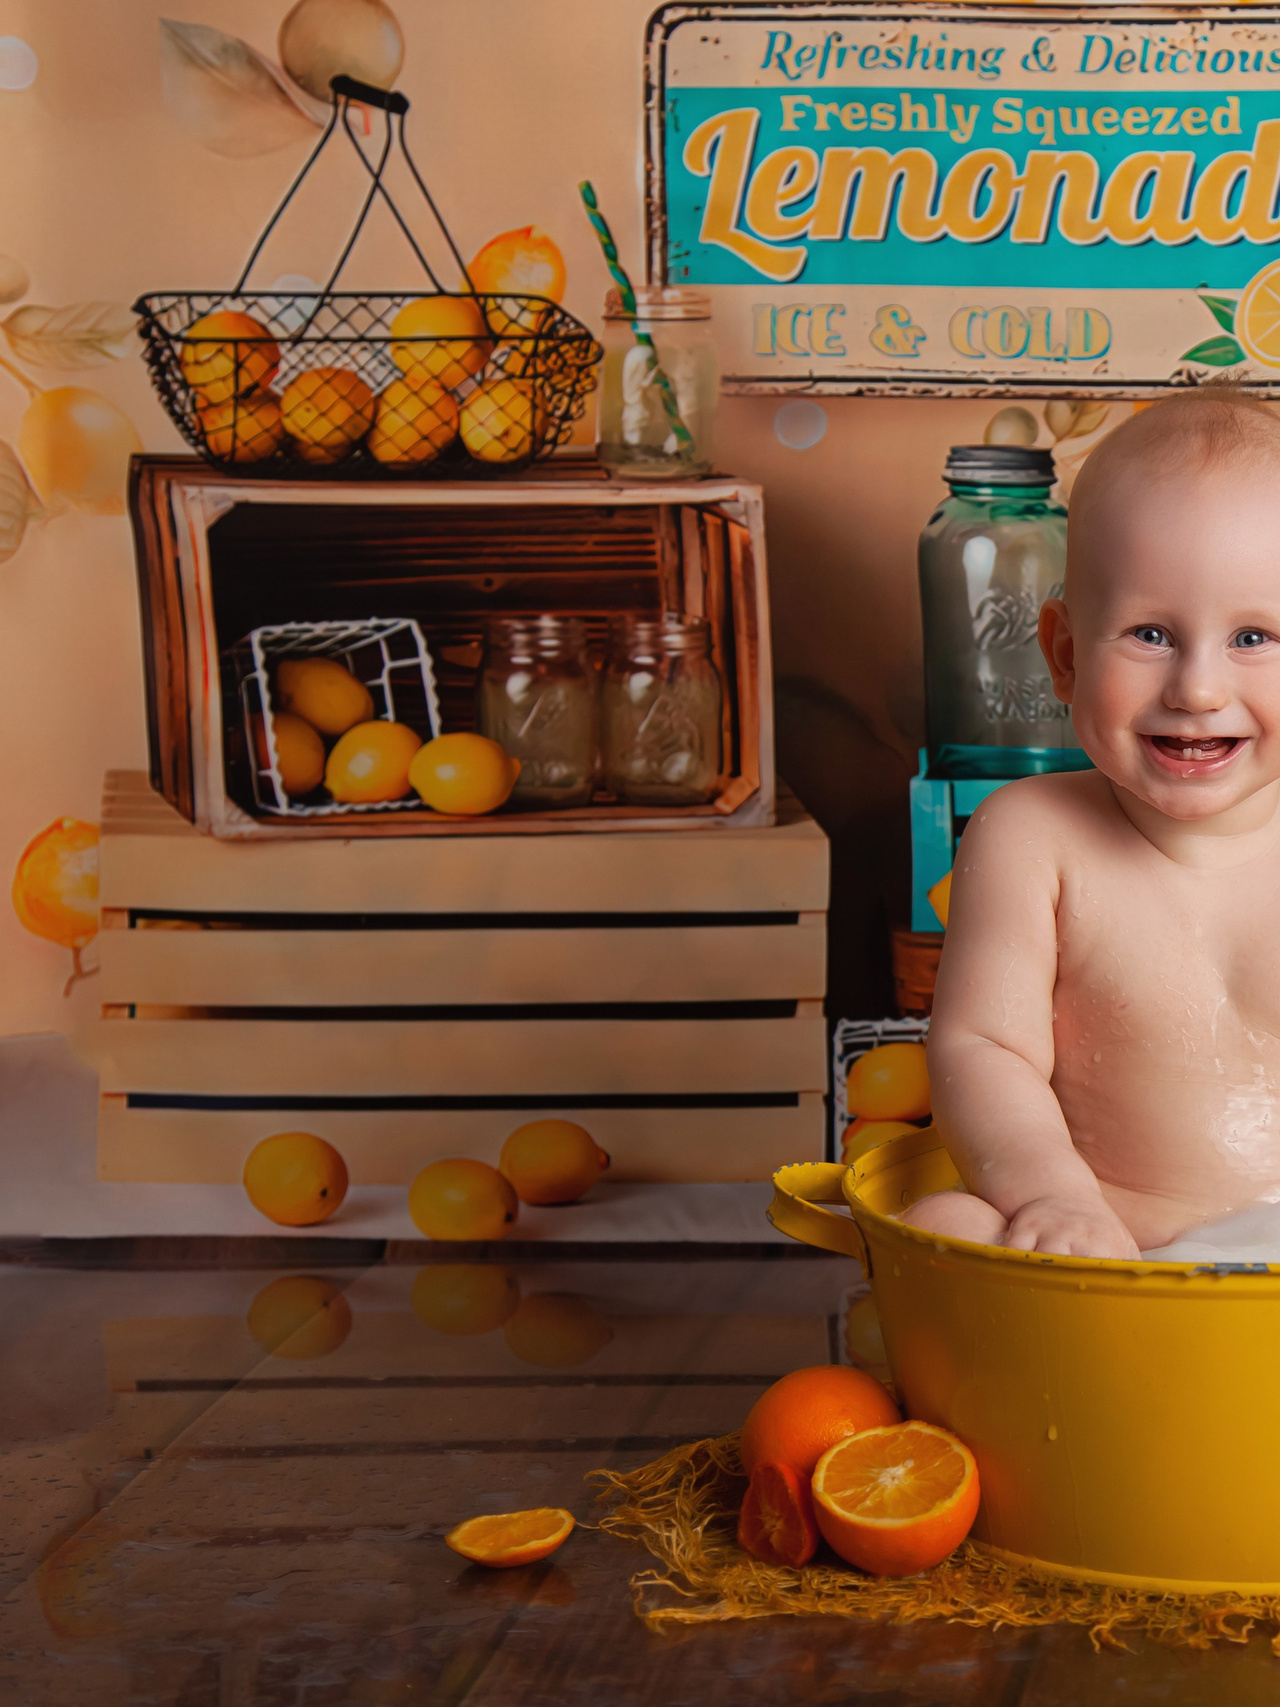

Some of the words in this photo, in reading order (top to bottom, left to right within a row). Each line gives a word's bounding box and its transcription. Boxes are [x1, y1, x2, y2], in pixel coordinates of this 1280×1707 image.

[760, 31, 1006, 81] Refreshing
[1021, 36, 1057, 73] &
[779, 93, 981, 144] Freshly
[992, 96, 1242, 145] Squeezed
[750, 303, 847, 357] ICE
[869, 304, 927, 357] &
[948, 305, 1112, 361] COLD
